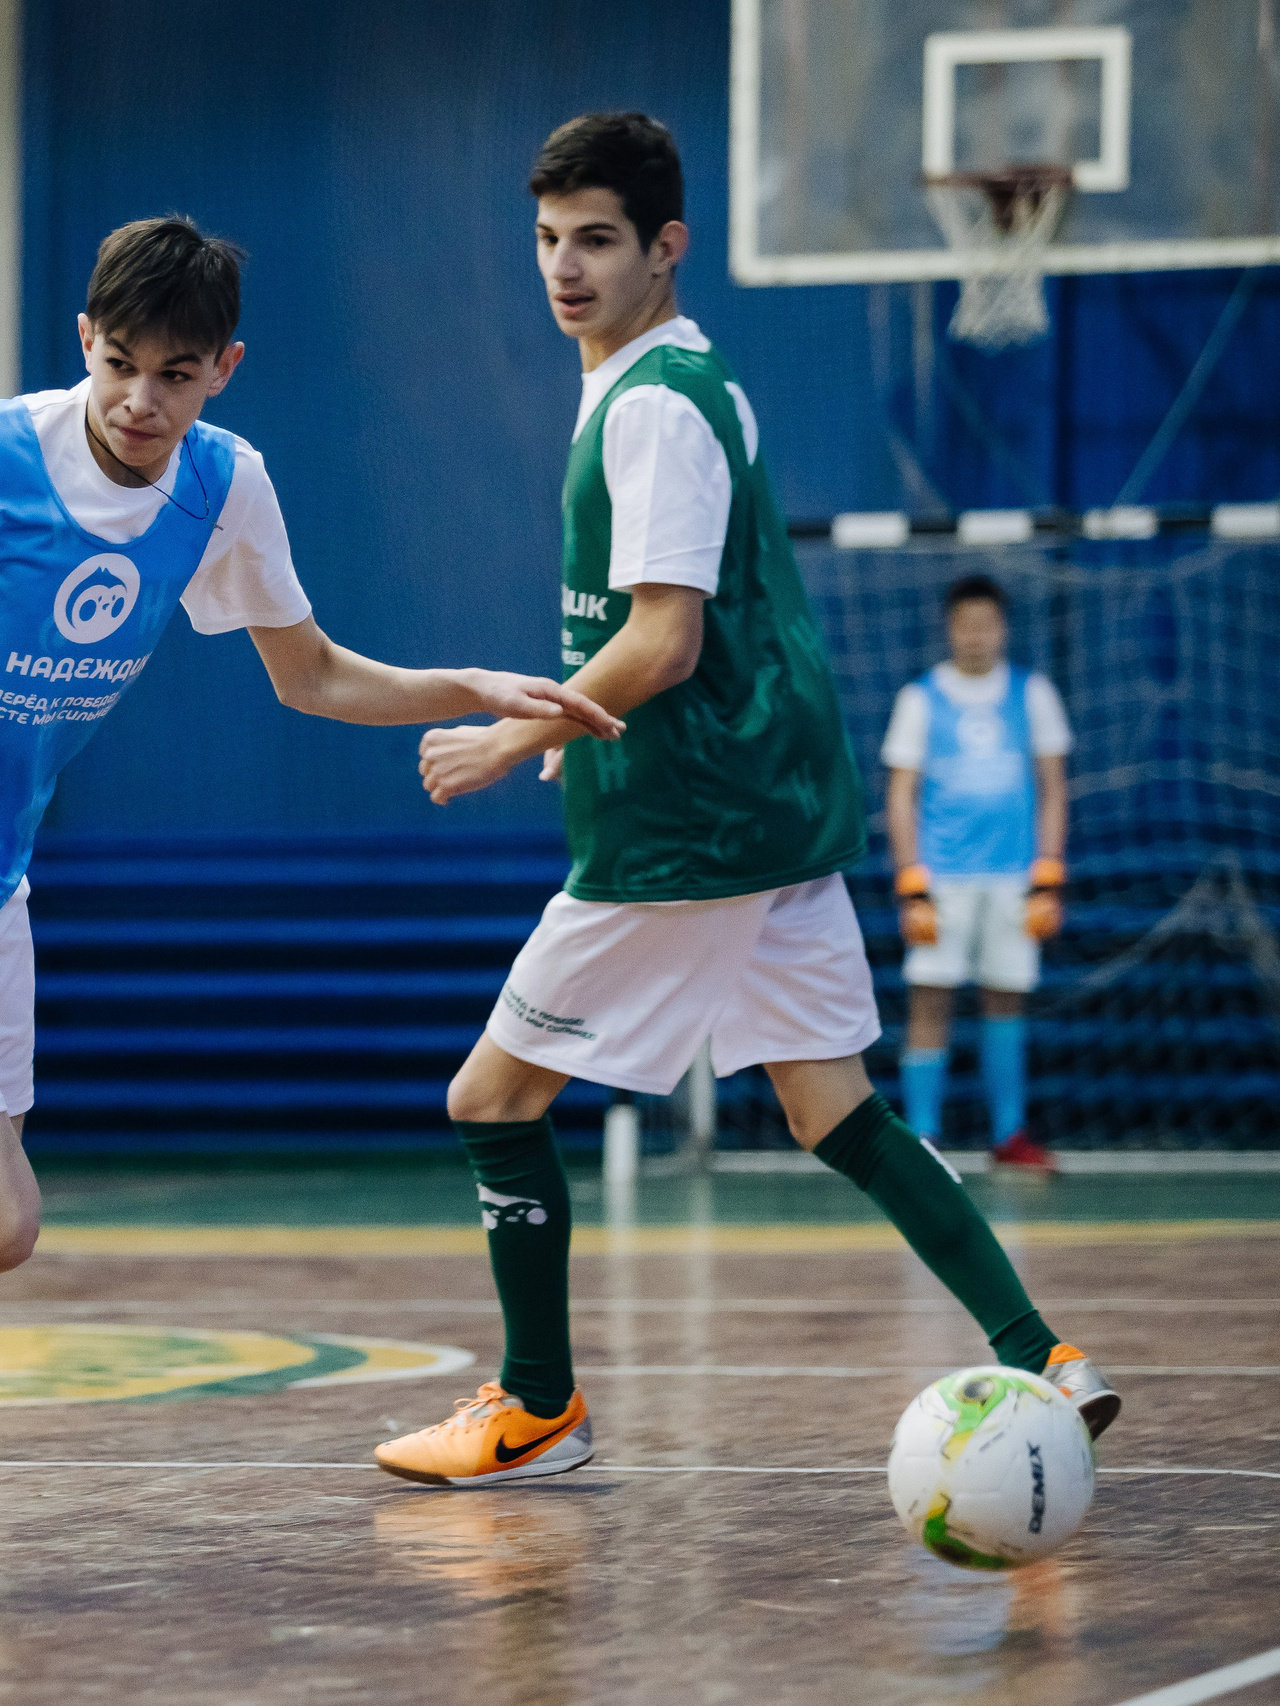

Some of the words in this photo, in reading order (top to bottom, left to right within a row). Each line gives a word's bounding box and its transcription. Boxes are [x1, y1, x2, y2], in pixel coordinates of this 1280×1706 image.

[5, 651, 153, 683] НАДЕЖДИ
[50, 697, 62, 710] К
[31, 711, 57, 726] МЫ
